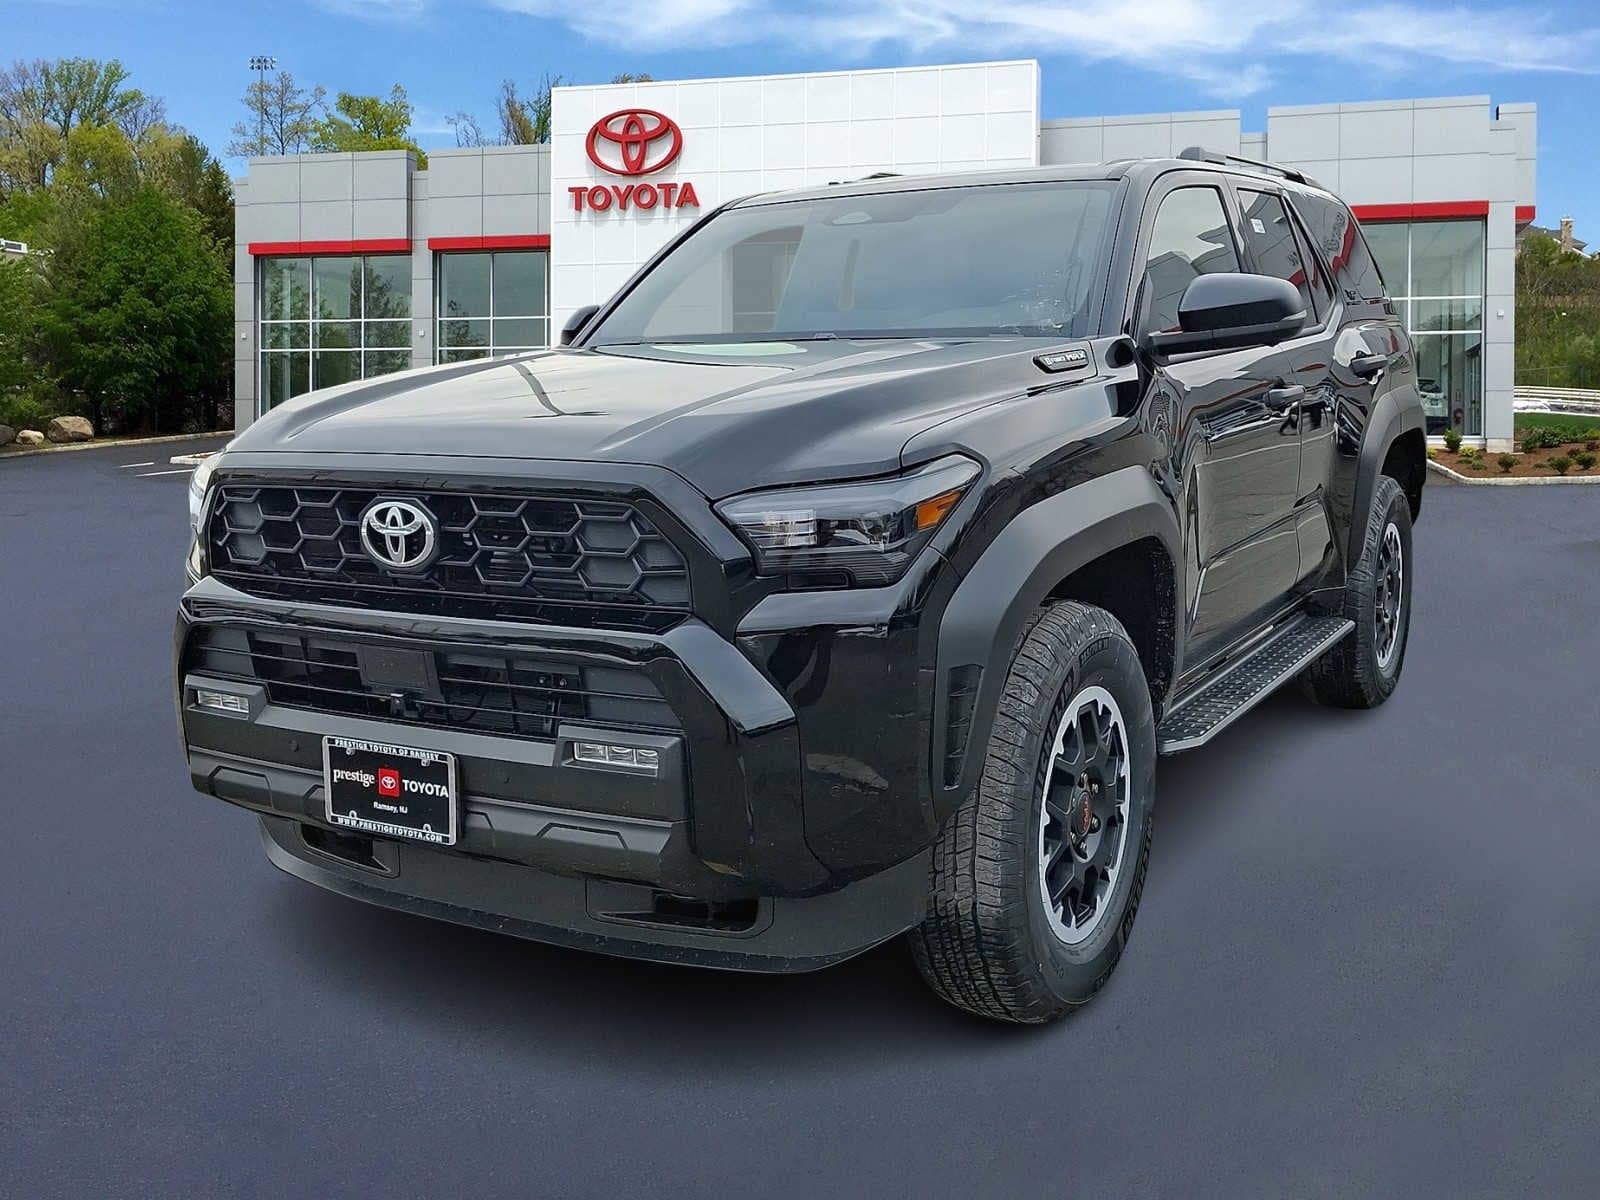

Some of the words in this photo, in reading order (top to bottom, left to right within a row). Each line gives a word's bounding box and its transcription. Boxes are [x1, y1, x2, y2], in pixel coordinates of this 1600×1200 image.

[568, 182, 700, 211] TOYOTA
[334, 739, 367, 750] PRESTIGE
[369, 744, 397, 755] TOYOTA
[398, 749, 408, 757] OF
[410, 750, 439, 761] RAMSEY
[333, 768, 375, 787] prestige
[402, 779, 449, 798] TOYOTA
[337, 817, 443, 843] WWW.PRESTIGETOYOTA.COM
